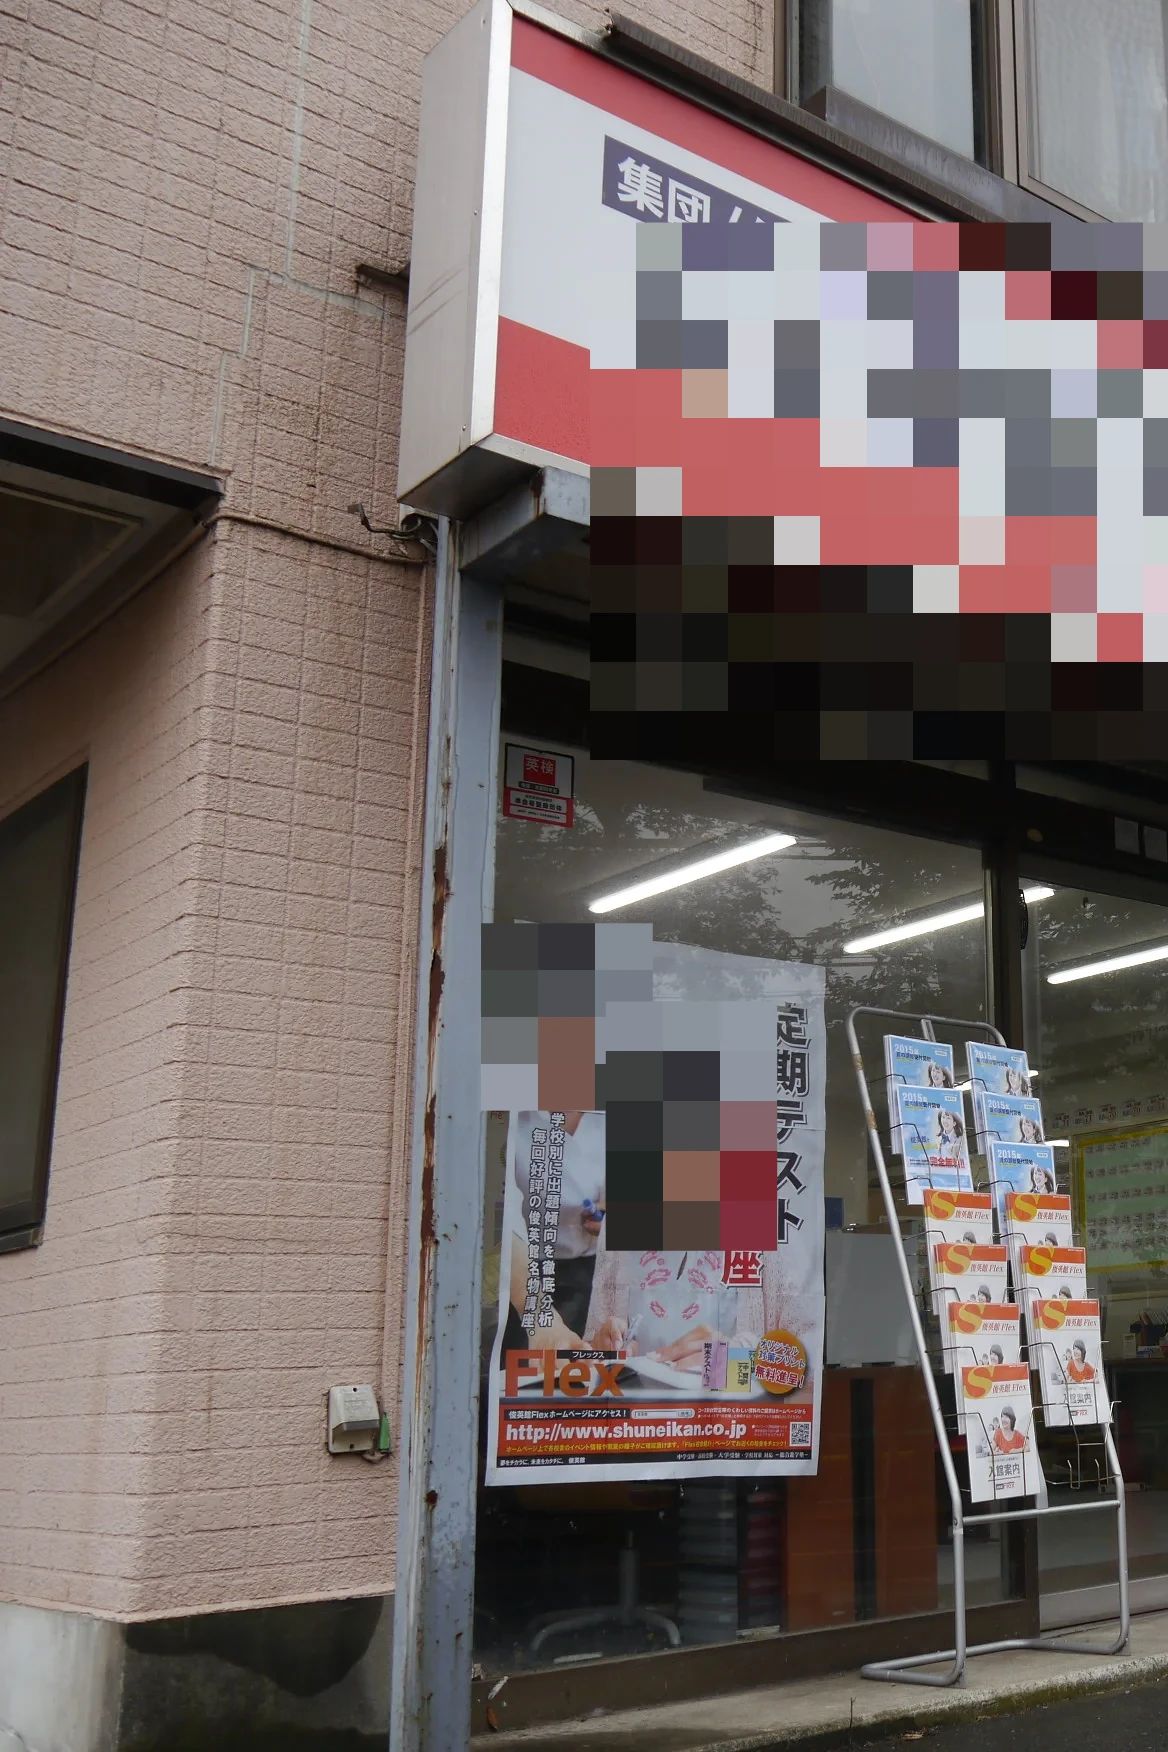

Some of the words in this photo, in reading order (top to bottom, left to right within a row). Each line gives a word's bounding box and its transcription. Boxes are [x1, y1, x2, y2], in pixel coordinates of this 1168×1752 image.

[973, 1210, 989, 1220] Flex
[1054, 1212, 1068, 1221] Flex
[538, 1112, 566, 1328] 学校別に出題傾向を徹底分析
[521, 1128, 548, 1337] 毎回好評の俊英館名物講座。
[989, 1263, 1004, 1272] Flex
[1069, 1265, 1083, 1274] Flex
[1001, 1321, 1016, 1331] Flex
[1083, 1318, 1097, 1327] Flex
[572, 1351, 605, 1359] フレックス
[505, 1350, 625, 1397] Flex
[1012, 1383, 1027, 1392] Flex
[506, 1420, 747, 1443] http://www.shuneikan.co.jp
